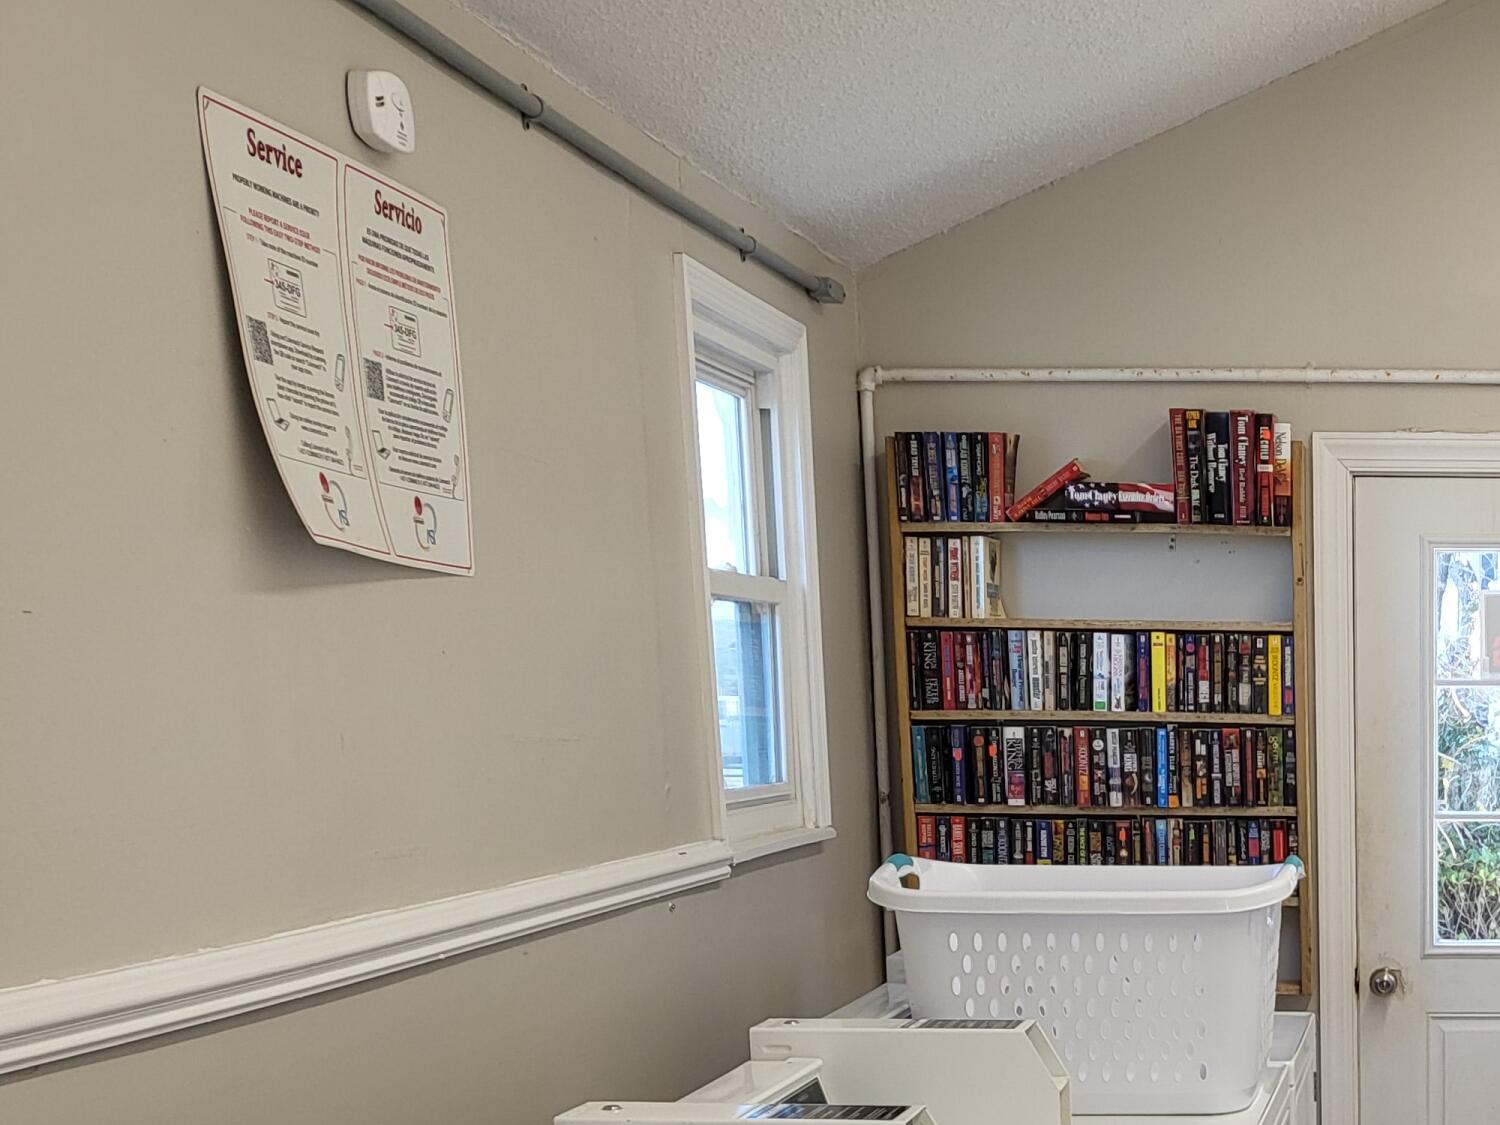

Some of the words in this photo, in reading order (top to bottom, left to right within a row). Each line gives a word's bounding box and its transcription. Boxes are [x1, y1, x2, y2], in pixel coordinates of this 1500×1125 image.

[246, 127, 303, 178] Service
[374, 189, 423, 235] Servicio
[1237, 415, 1248, 434] Tom
[1218, 443, 1228, 458] Tom
[1234, 436, 1248, 465] Clancy
[1275, 431, 1289, 456] Nelson
[1216, 459, 1228, 483] Clancy
[1069, 490, 1088, 501] Tom
[923, 642, 932, 670] KING
[931, 678, 939, 703] PETER
[1007, 739, 1016, 770] KING
[1015, 738, 1023, 770] STEPHEN
[1079, 747, 1088, 775] KOONTZ
[1123, 753, 1132, 772] KING
